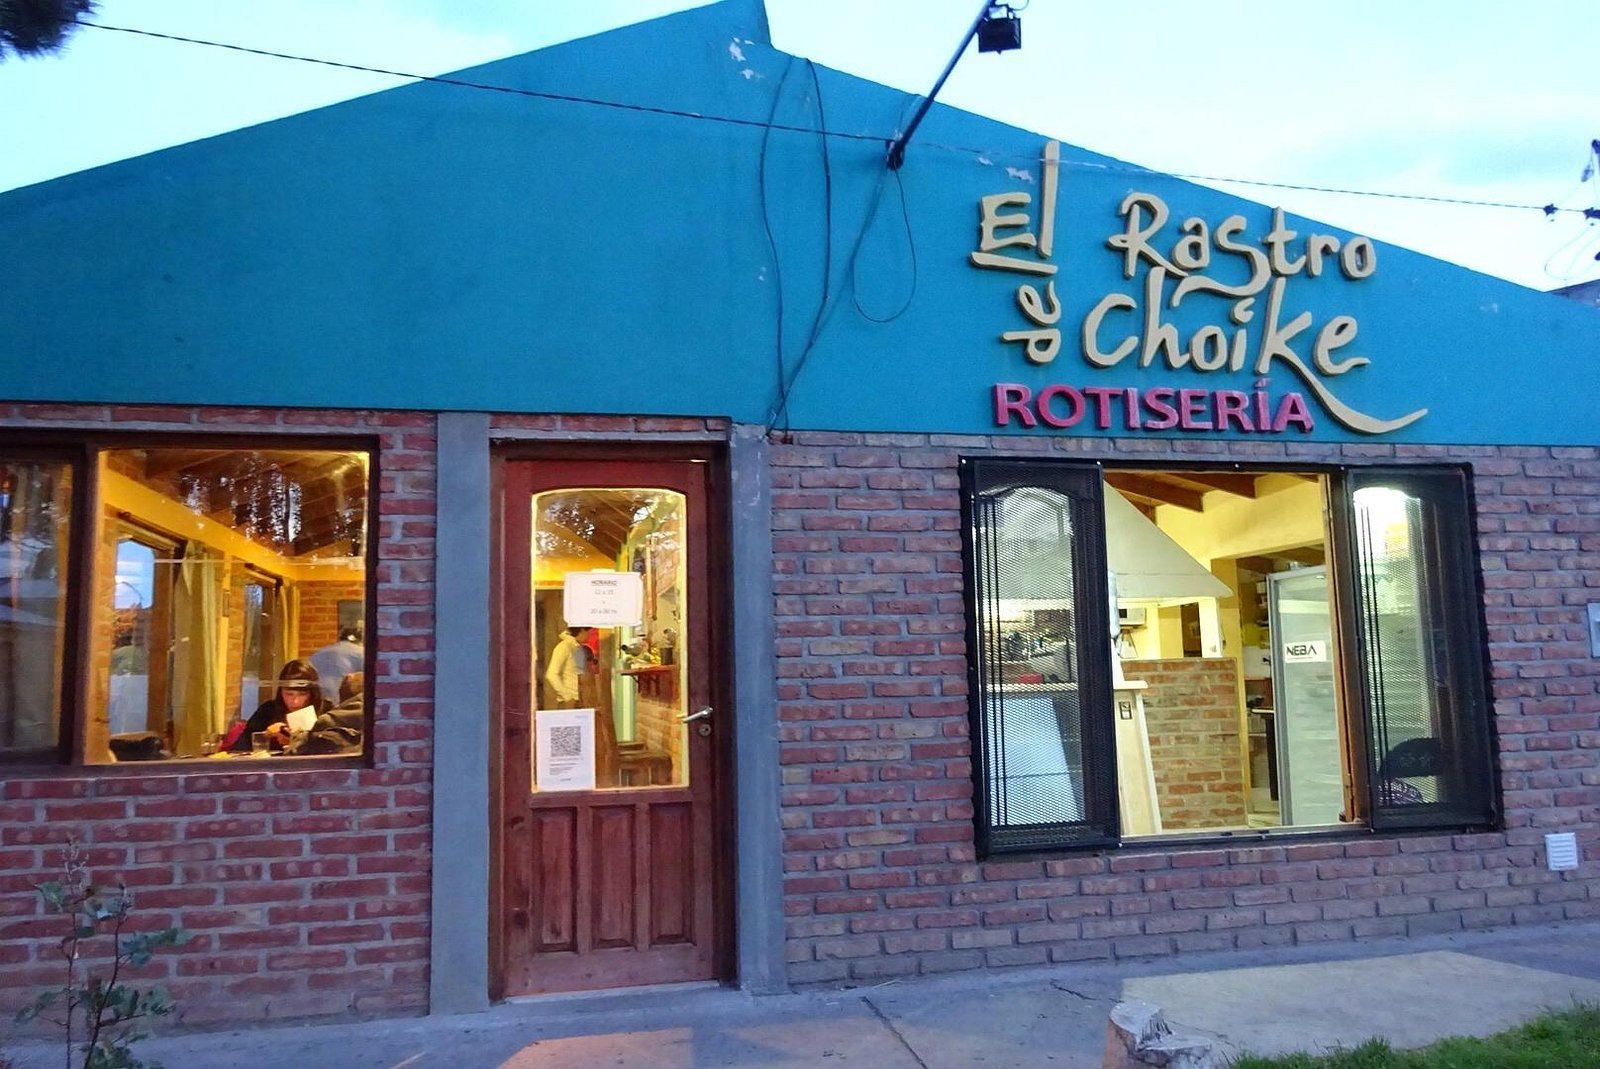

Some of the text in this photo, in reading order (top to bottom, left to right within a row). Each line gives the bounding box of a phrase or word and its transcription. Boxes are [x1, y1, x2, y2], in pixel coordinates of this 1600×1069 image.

[980, 140, 1060, 258] El
[1107, 192, 1376, 308] Rastro
[971, 251, 1062, 365] del
[992, 378, 1315, 434] ROTISERÍA
[1286, 644, 1317, 656] NEBA
